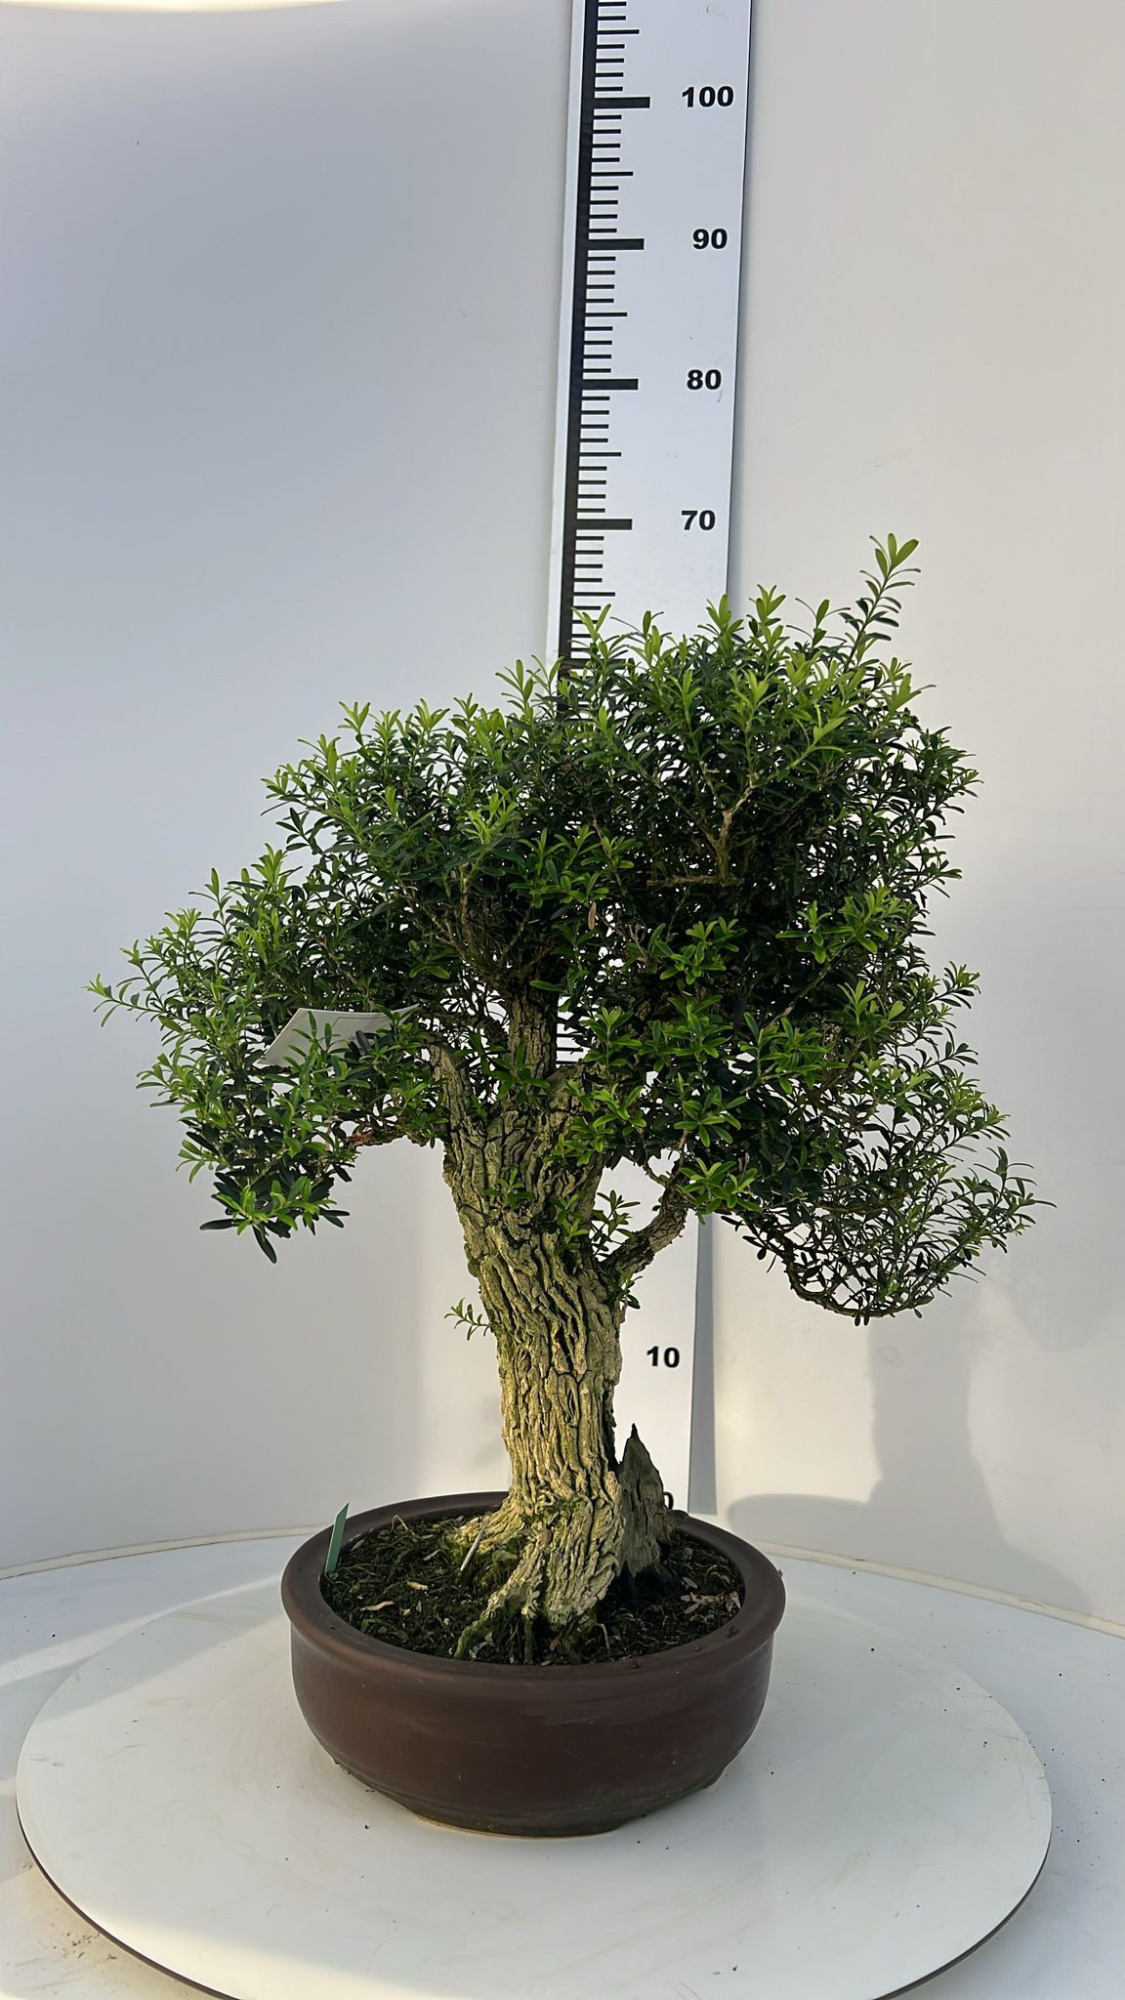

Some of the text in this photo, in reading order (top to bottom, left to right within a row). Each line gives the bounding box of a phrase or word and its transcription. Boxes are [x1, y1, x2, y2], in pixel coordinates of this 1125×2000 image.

[682, 86, 734, 108] 100
[692, 228, 728, 250] 90
[686, 369, 722, 390] 80
[681, 510, 716, 531] 70
[646, 1346, 680, 1368] 10
